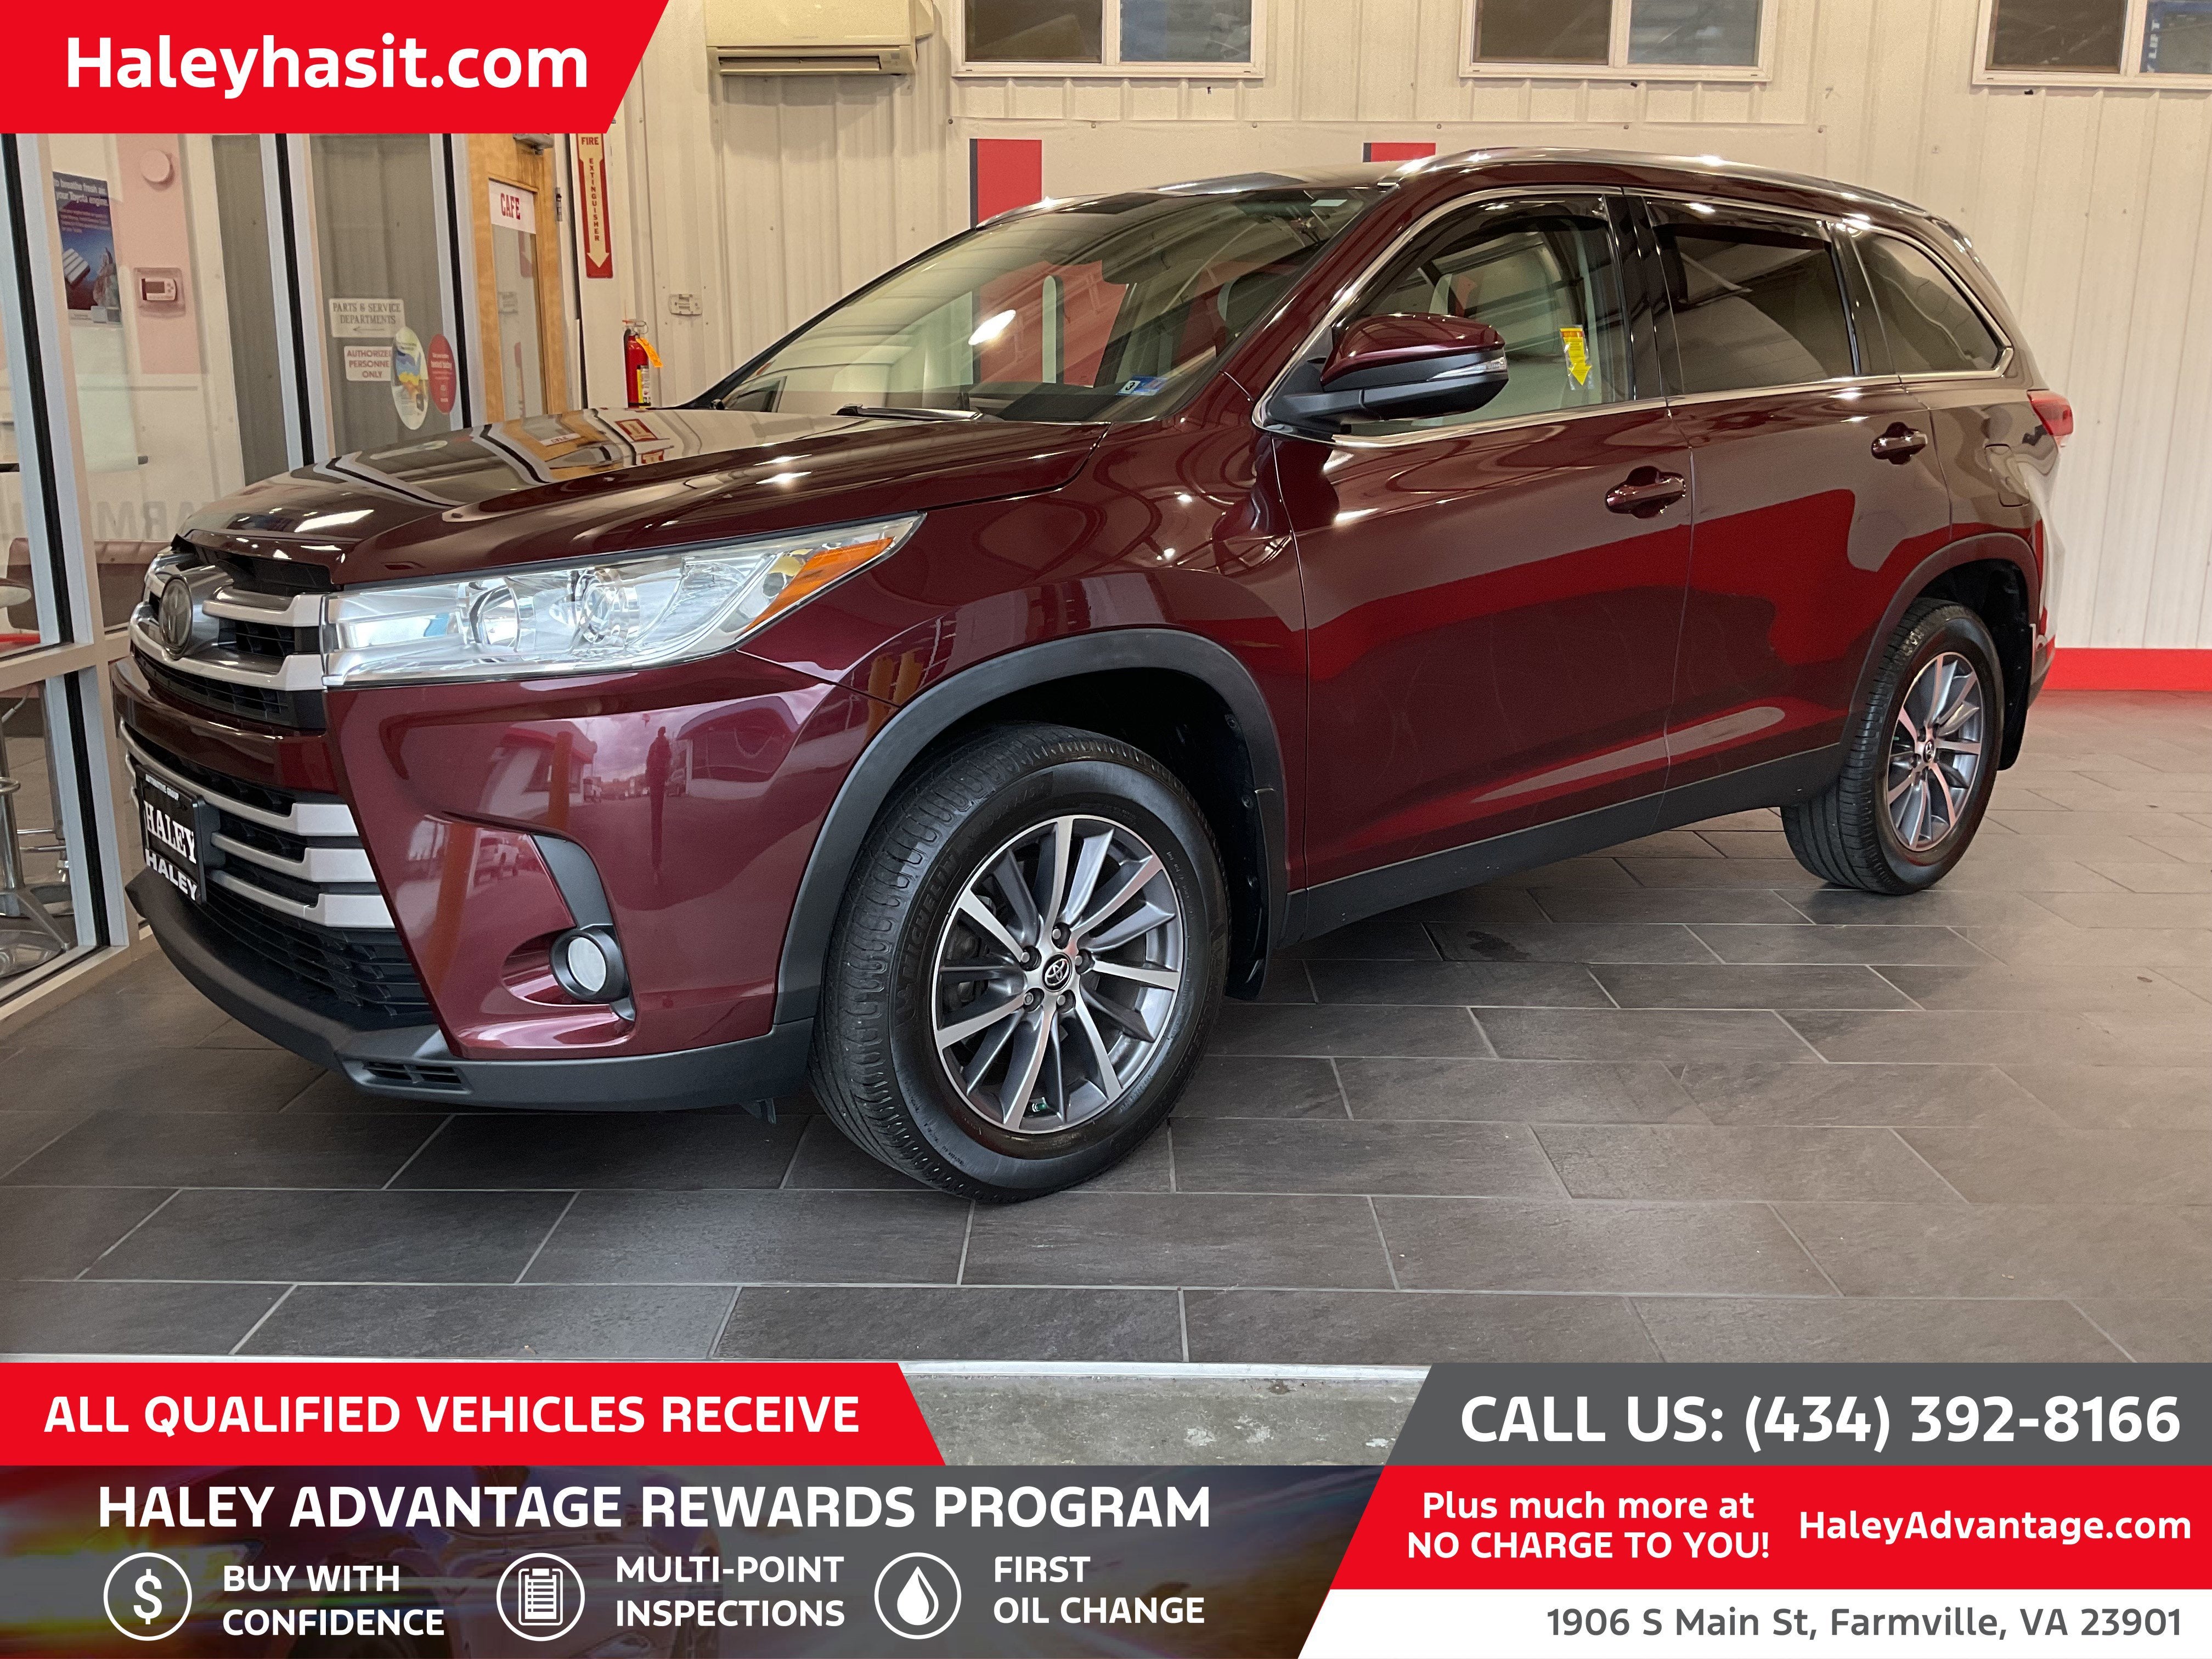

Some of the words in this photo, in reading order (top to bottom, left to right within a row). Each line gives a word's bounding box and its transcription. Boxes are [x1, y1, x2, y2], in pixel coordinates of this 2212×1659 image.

[581, 137, 599, 145] FIRE
[69, 191, 88, 204] Toyota
[500, 193, 521, 220] CAFE
[589, 158, 600, 241] EXTINGUISHER
[333, 303, 357, 312] PARTS
[368, 303, 400, 313] SERVICE
[340, 314, 396, 324] DEPARTMENTS
[1125, 382, 1136, 391] 3
[144, 800, 196, 865] HALEY
[145, 848, 198, 901] HALEY
[901, 854, 960, 979] MICHELIN
